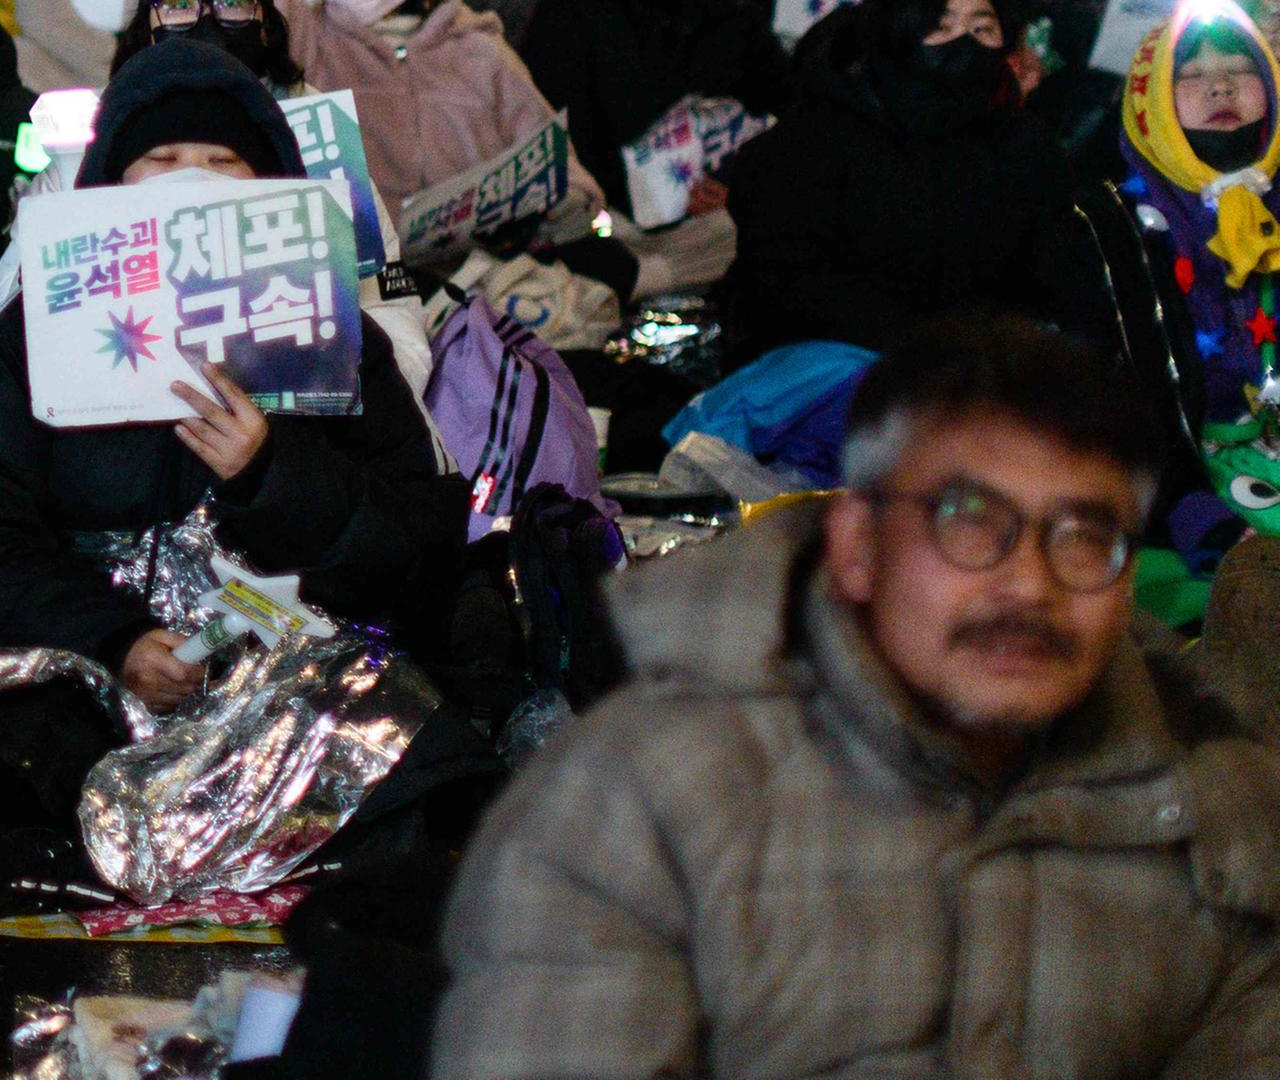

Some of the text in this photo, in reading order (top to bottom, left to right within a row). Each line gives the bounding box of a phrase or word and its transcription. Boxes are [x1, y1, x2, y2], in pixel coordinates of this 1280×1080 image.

[40, 217, 160, 269] 내란수괴
[170, 191, 329, 282] 체포!
[45, 252, 161, 314] 윤석열
[180, 271, 337, 363] 구속!
